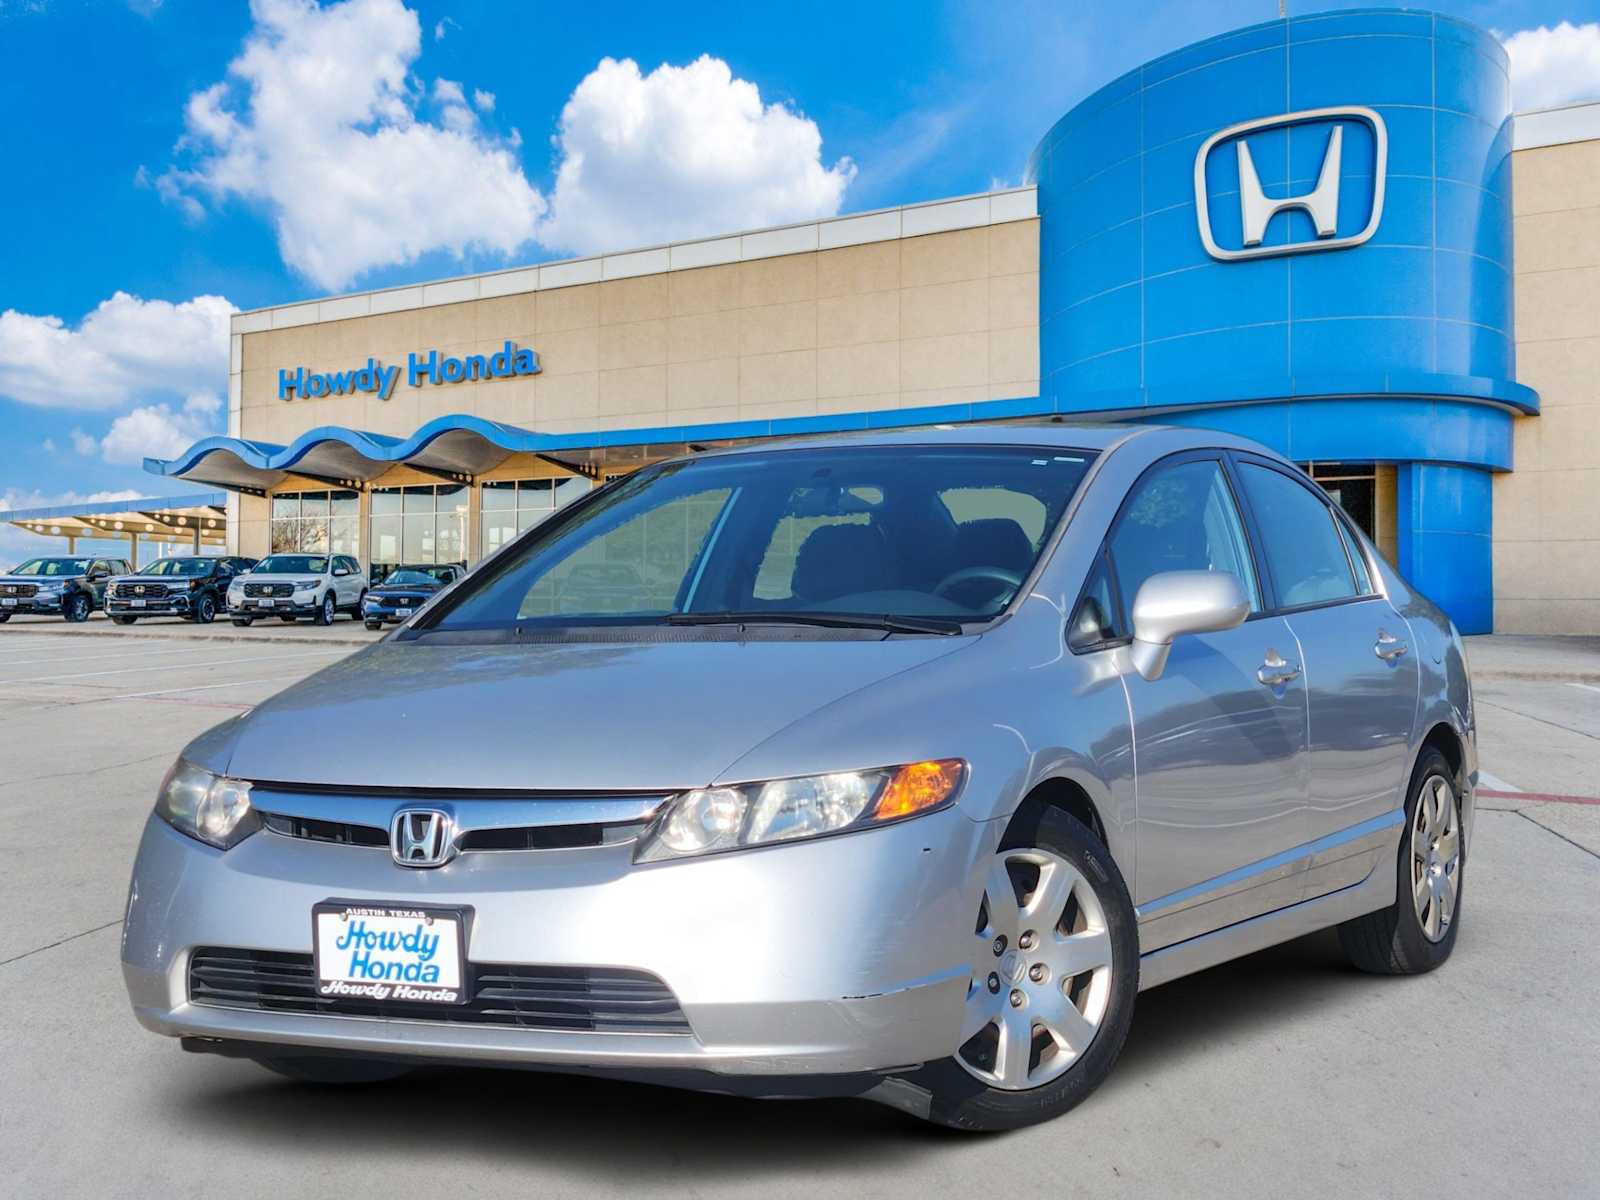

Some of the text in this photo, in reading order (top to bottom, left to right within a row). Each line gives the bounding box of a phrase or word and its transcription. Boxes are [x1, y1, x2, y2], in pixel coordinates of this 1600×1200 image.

[278, 340, 541, 401] Howdy Honda
[345, 907, 426, 919] AUSTIN TEXAS
[336, 920, 440, 961] Howdy
[348, 950, 441, 983] Honda
[321, 981, 458, 1002] Howdy Honda
